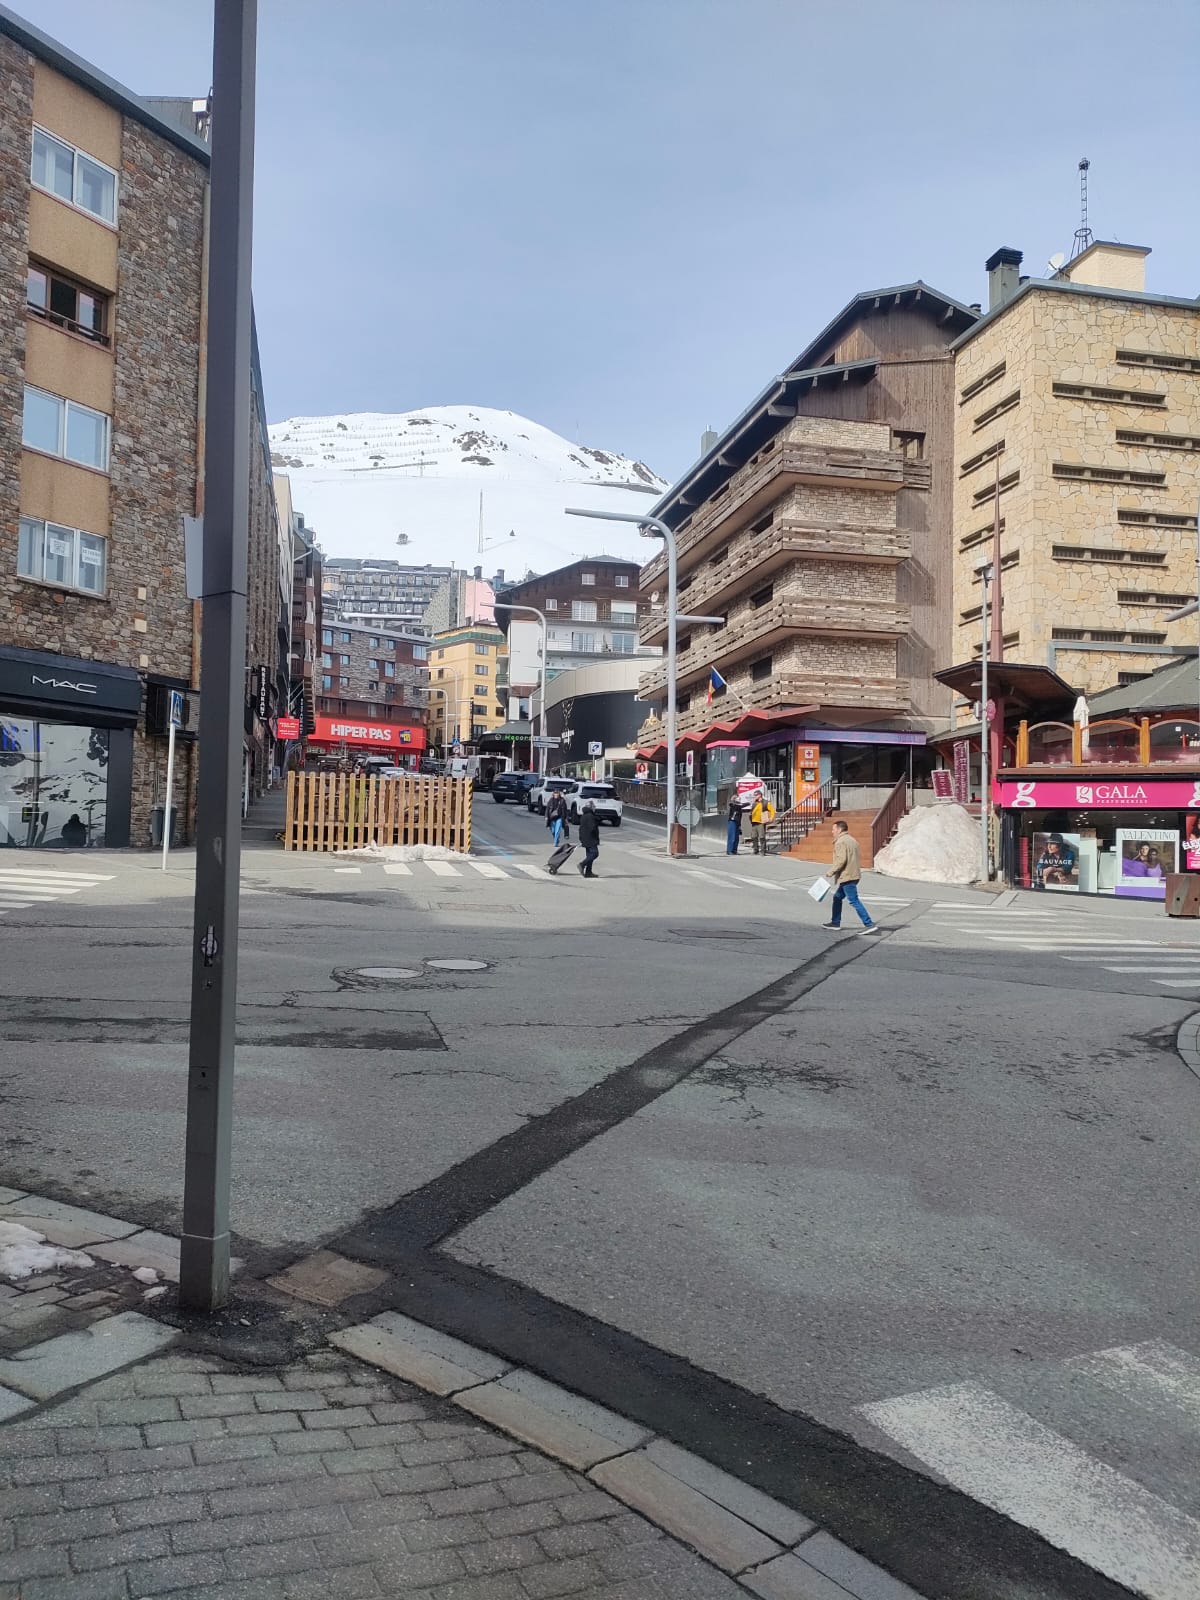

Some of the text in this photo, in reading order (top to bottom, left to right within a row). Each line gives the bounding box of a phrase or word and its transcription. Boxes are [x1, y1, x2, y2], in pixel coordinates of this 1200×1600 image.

[32, 675, 97, 694] MAC
[330, 723, 368, 739] HIPER
[369, 727, 392, 741] PAS
[1095, 785, 1148, 799] GALA
[1121, 830, 1176, 840] VALENTINO
[1038, 858, 1073, 866] SAUVAGE
